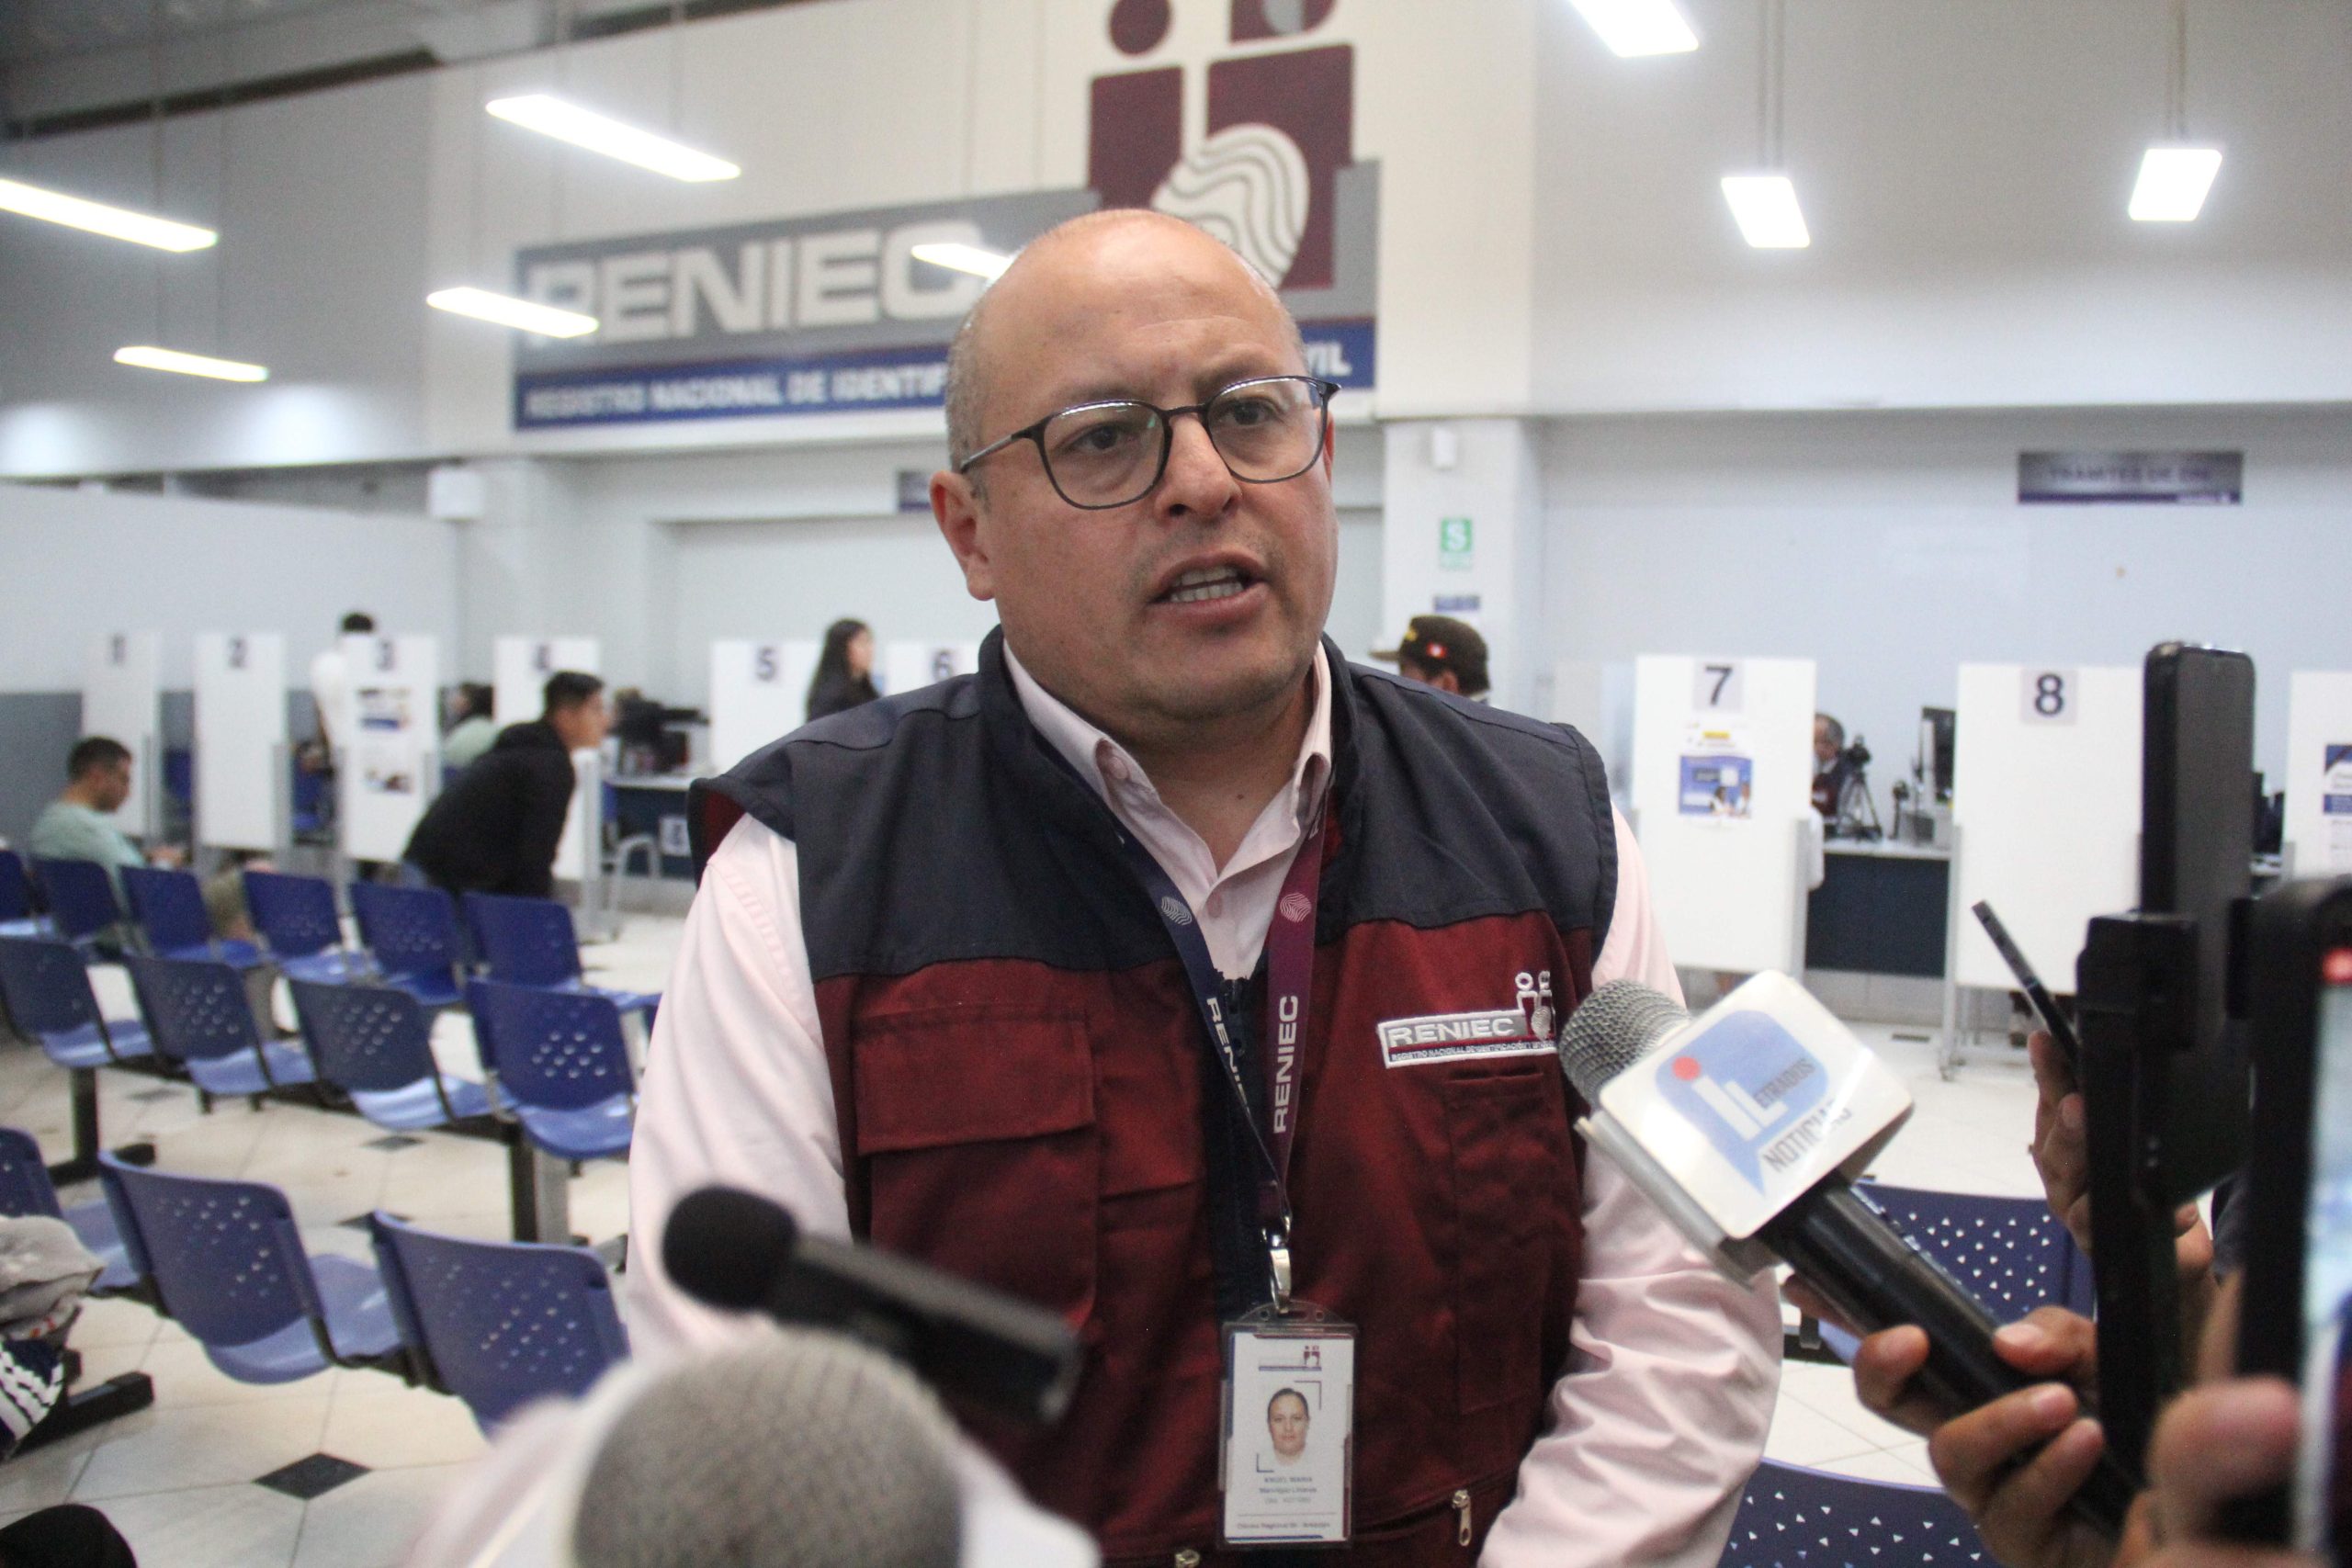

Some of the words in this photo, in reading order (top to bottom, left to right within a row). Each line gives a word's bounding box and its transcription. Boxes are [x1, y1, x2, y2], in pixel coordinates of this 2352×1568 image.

[230, 638, 247, 669] 2
[754, 648, 777, 682] 5
[932, 649, 955, 679] 6
[1705, 665, 1733, 705] 7
[2034, 673, 2063, 716] 8
[1386, 1018, 1515, 1047] RENIEC
[1273, 995, 1298, 1134] RENIEC
